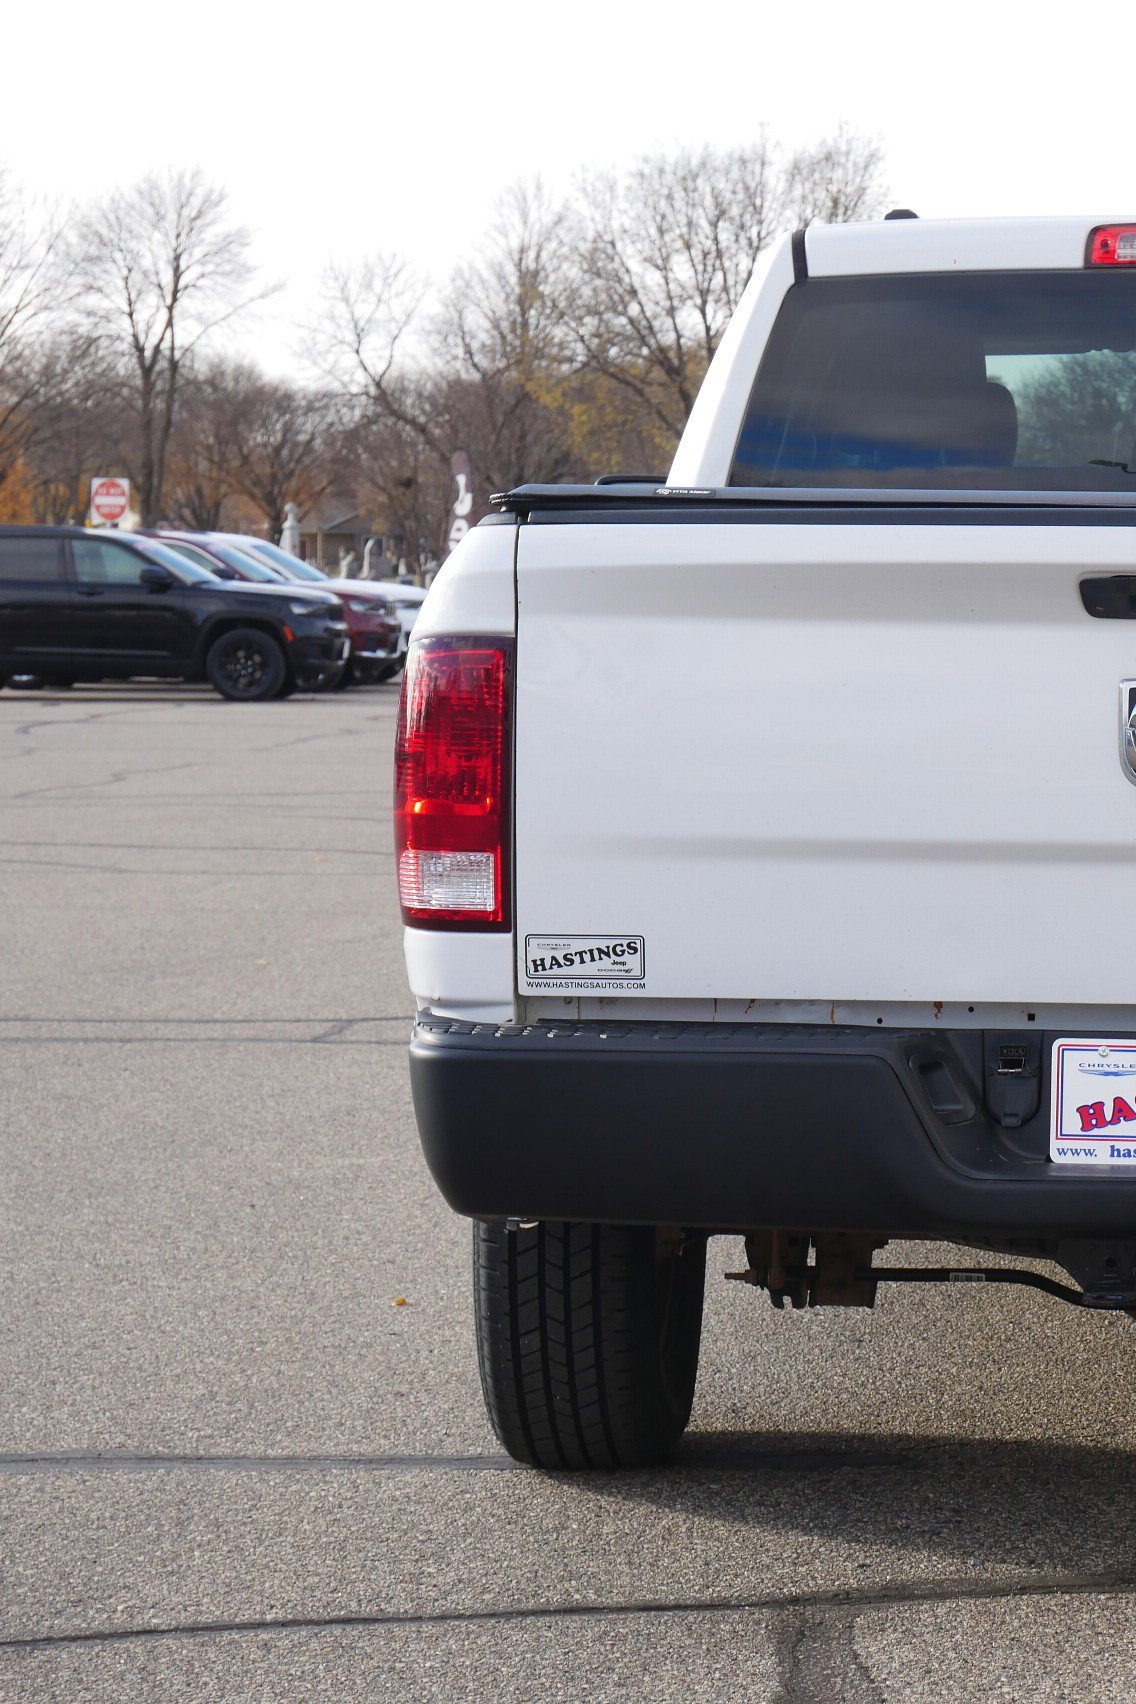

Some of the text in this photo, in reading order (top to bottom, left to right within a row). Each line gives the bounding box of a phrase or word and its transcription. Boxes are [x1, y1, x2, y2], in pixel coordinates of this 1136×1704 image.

[531, 941, 639, 973] HASTINGS
[526, 980, 646, 989] WWW.HASTINGSAUTOS.COM
[1056, 1147, 1098, 1157] www.
